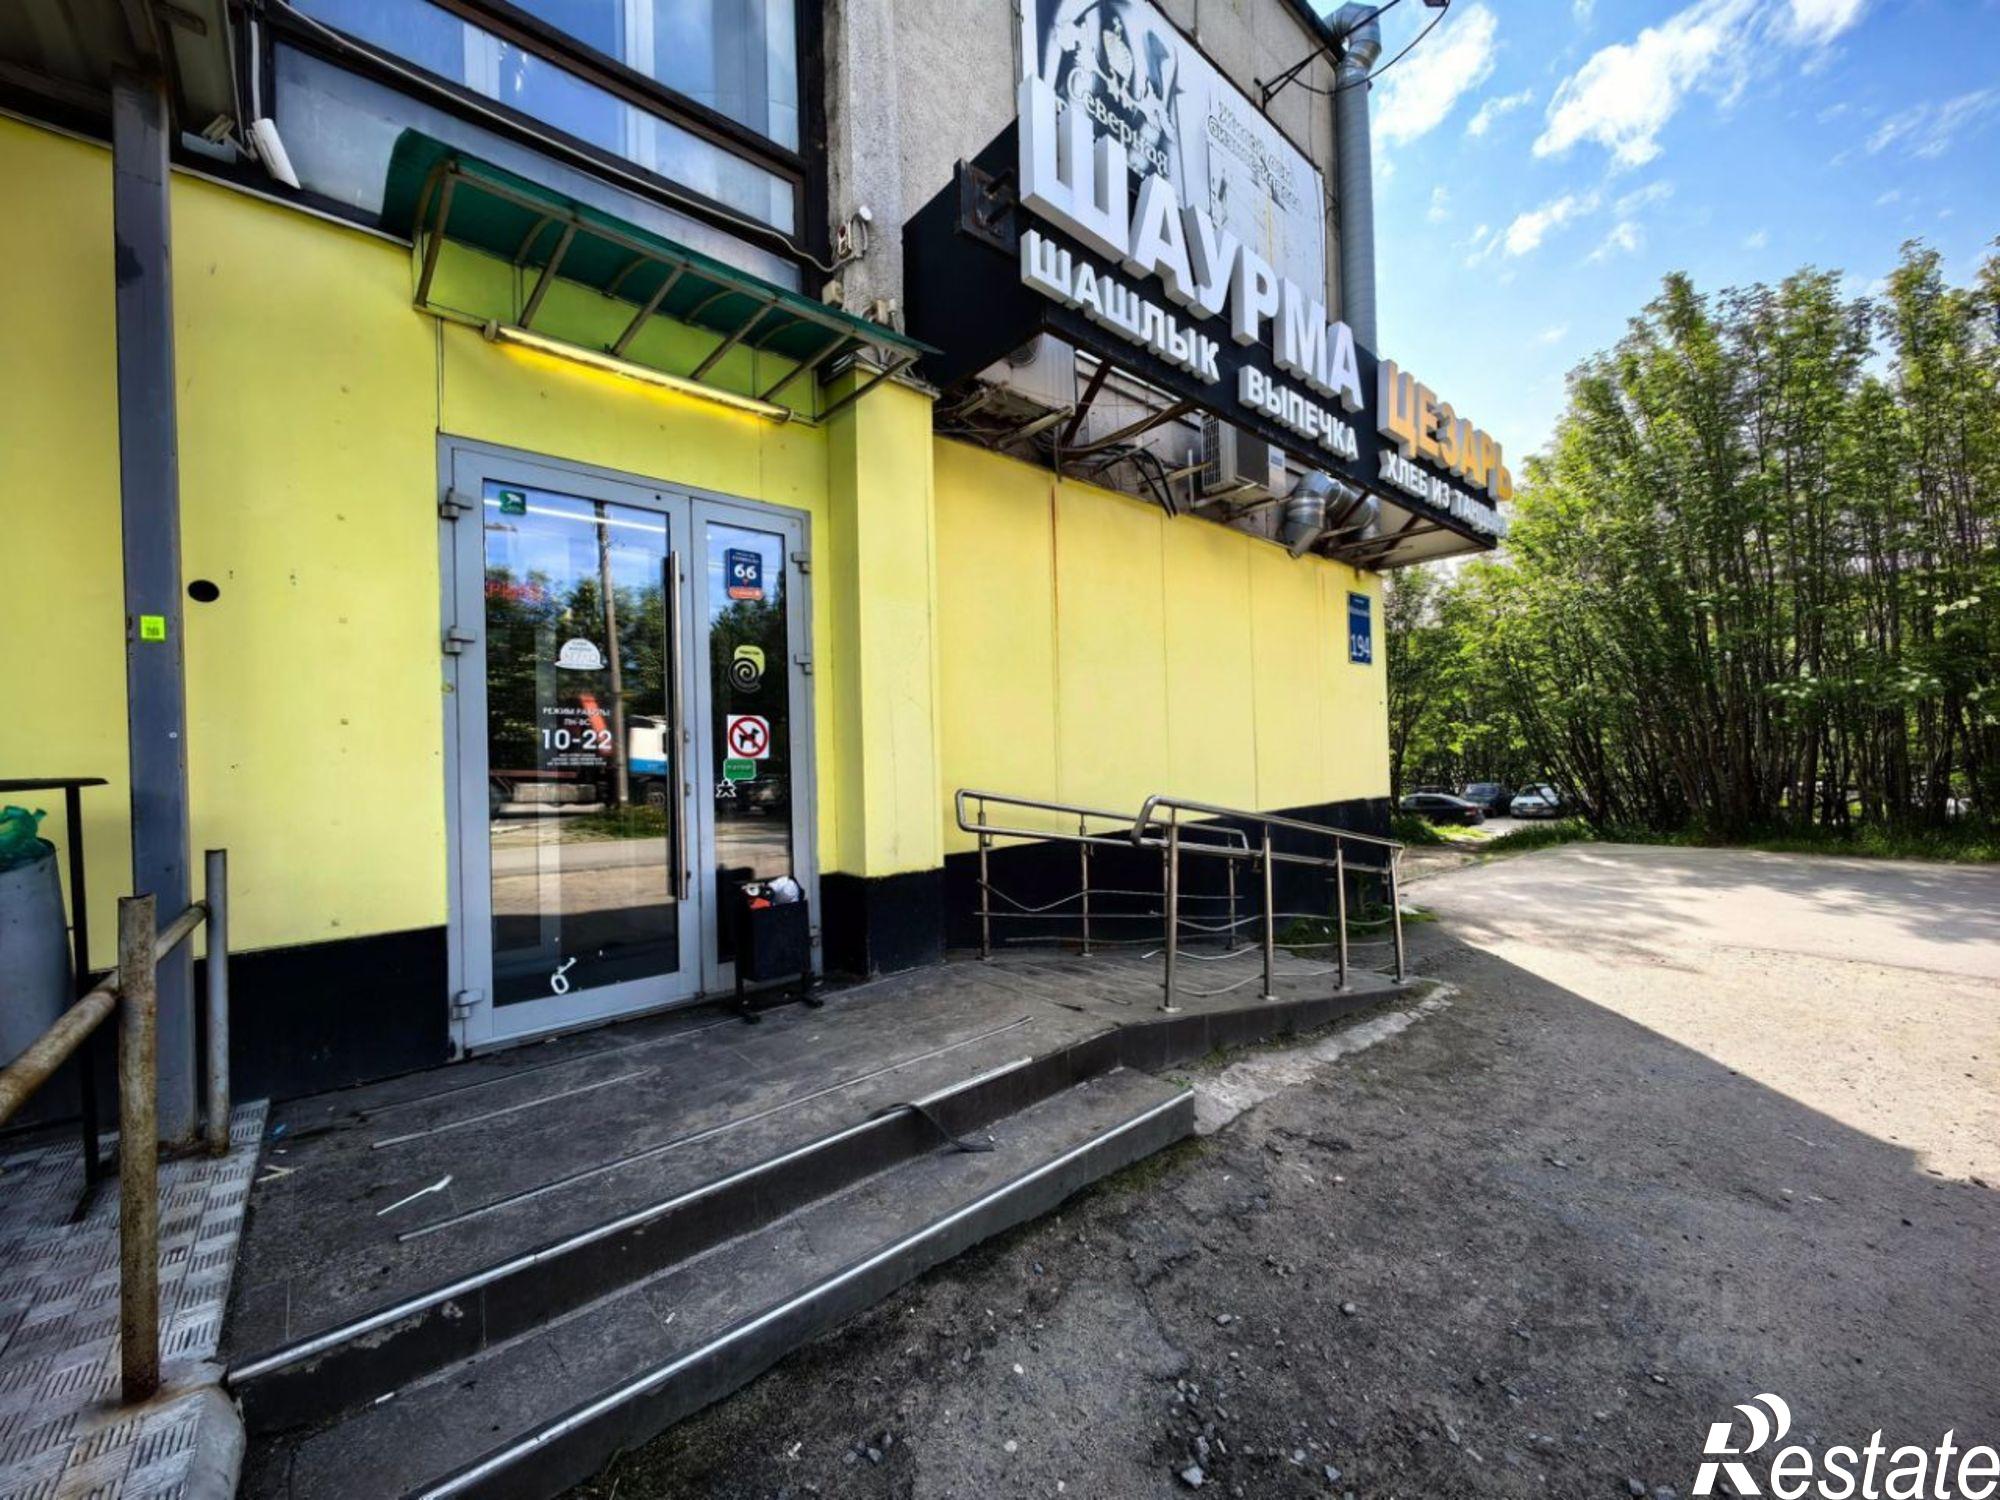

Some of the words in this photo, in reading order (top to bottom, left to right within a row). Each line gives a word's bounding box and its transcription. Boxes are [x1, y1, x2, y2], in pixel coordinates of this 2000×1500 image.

[1018, 72, 1364, 413] ШАУРМА
[1020, 229, 1221, 385] ШАШЛЫК
[1238, 364, 1360, 462] ВЫПЕЧКА
[1377, 358, 1514, 502] ЦЕЗАРЬ
[1378, 449, 1428, 498] ХЛЕБ
[1426, 475, 1451, 510] ИЗ
[734, 563, 758, 581] 66
[541, 728, 612, 750] 10-22
